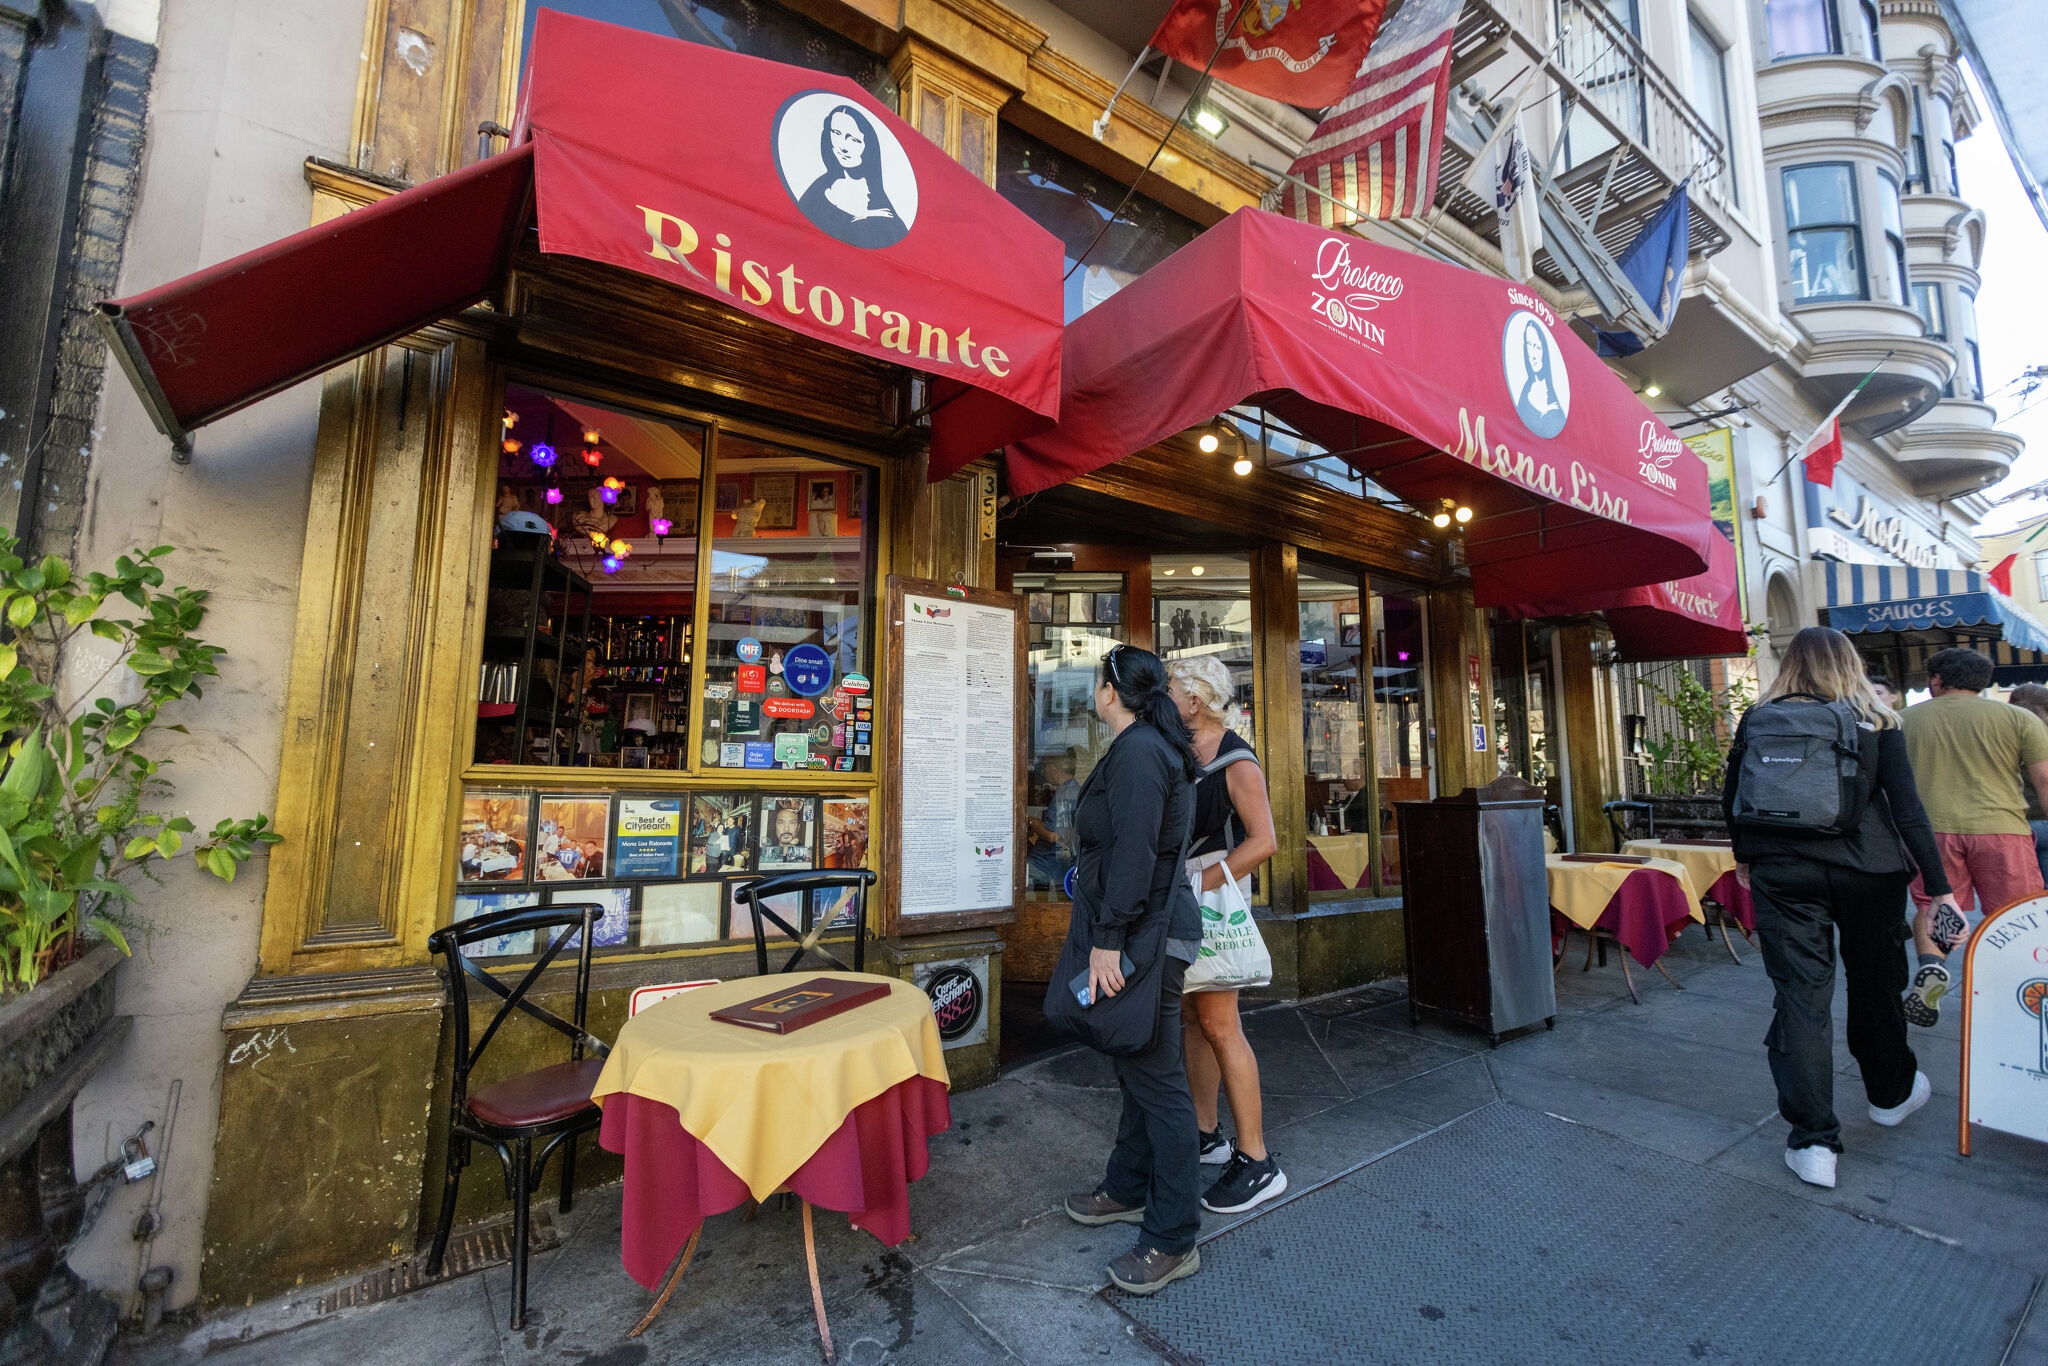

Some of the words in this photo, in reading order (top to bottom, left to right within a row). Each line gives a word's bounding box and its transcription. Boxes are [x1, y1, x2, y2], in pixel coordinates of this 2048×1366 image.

[1256, 48, 1291, 66] MARINE
[1293, 50, 1325, 72] CORPS
[636, 204, 1011, 378] Ristorante
[1312, 238, 1404, 310] Prosecco
[1311, 291, 1386, 347] ZONIN
[1507, 288, 1534, 310] Since
[1535, 298, 1555, 327] 1979
[1447, 407, 1563, 500] Mona
[1570, 460, 1633, 524] Lisa
[1638, 461, 1677, 491] ZONIN
[1867, 600, 1954, 622] SAUCES
[843, 679, 869, 689] Calabria
[625, 821, 671, 831] Citysearch
[1203, 925, 1254, 940] EUSABLE
[1214, 938, 1256, 951] REDUCE
[1986, 912, 2039, 950] BENT
[931, 975, 973, 1013] ERGNANO
[936, 990, 973, 1028] 1882
